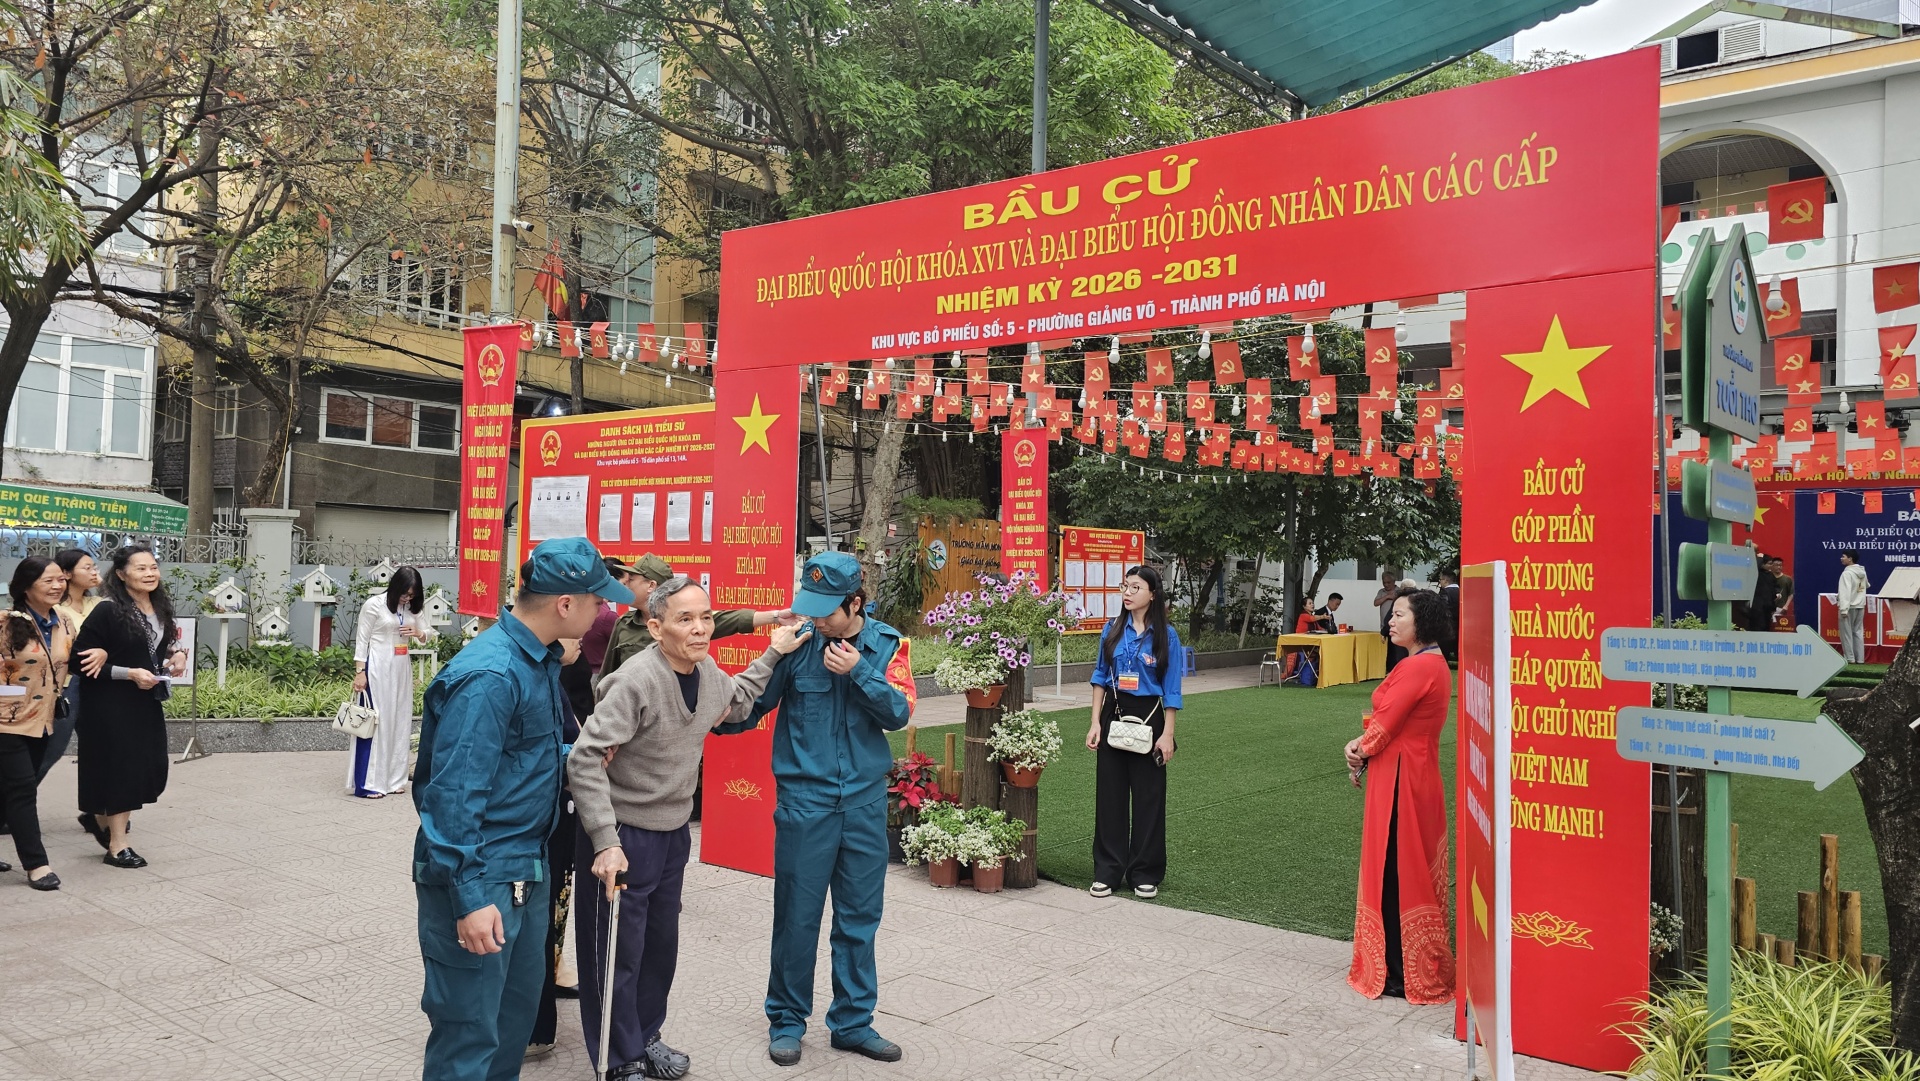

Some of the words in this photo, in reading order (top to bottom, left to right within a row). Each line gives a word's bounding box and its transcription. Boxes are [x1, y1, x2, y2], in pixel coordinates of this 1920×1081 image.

[963, 183, 1080, 231] BẦU
[1102, 154, 1199, 204] CỬ
[757, 274, 784, 308] ĐẠI
[787, 255, 825, 298] BIỂU
[829, 251, 876, 299] QUỐC
[880, 248, 913, 293] HỘI
[917, 241, 969, 279] KHÓA
[971, 242, 1005, 274] XVI
[1009, 228, 1036, 269] VÀ
[1041, 229, 1078, 269] ĐẠI
[1083, 204, 1137, 258] BIỂU
[1142, 203, 1186, 254] HỘI
[1190, 188, 1264, 241] ĐỒNG
[1268, 177, 1348, 229] NHÂN
[1352, 165, 1415, 215] DÂN
[1422, 152, 1484, 203] CÁC
[1492, 132, 1559, 190] CẤP
[936, 286, 1019, 314] NHIỆM
[1028, 276, 1063, 304] KỲ
[1071, 268, 1142, 299] 2026
[871, 334, 895, 350] KHU
[897, 331, 921, 349] VỰC
[923, 326, 940, 345] BỎ
[942, 320, 979, 343] PHIẾU
[982, 318, 1004, 339] SỐ:
[1006, 321, 1015, 336] 5
[1027, 312, 1084, 334] PHƯỜNG
[1087, 304, 1132, 327] GIẢNG
[1136, 300, 1156, 320] VÕ
[1170, 293, 1223, 316] THÀNH
[1227, 284, 1263, 306] PHỐ
[1266, 281, 1291, 304] HÀ
[1294, 278, 1326, 301] NỘI
[600, 427, 620, 437] DANH
[622, 424, 642, 436] SÁCH
[643, 422, 654, 434] VÀ
[655, 419, 672, 432] TIỂU
[674, 419, 686, 431] SỬ
[1523, 457, 1558, 496] BẦU
[1560, 458, 1586, 496] CỬ
[0, 490, 19, 501] EM
[24, 493, 50, 505] QUE
[54, 496, 96, 511] TRÀNG
[100, 500, 127, 514] TIỀN
[0, 506, 18, 517] EM
[22, 504, 38, 519] ỐC
[42, 508, 68, 522] QUẾ
[742, 489, 754, 514] BẦU
[756, 490, 766, 514] CỬ
[723, 526, 734, 548] ĐẠI
[735, 517, 750, 544] BIỂU
[752, 519, 770, 548] QUỐC
[770, 522, 782, 548] HỘI
[1512, 508, 1546, 543] GÓP
[1548, 504, 1595, 542] PHẦN
[1856, 528, 1874, 538] ĐẠI
[1878, 524, 1904, 536] BIỂU
[1822, 539, 1836, 550] VÀ
[1860, 538, 1885, 550] BIỂU
[1888, 540, 1908, 552] HỘI
[1884, 554, 1916, 563] NHIỆM
[736, 552, 754, 575] KHÓA
[755, 557, 766, 574] XVI
[1510, 556, 1543, 590] XÂY
[1545, 559, 1594, 598] DỰNG
[716, 582, 724, 604] VÀ
[725, 587, 736, 608] ĐẠI
[737, 578, 752, 605] BIỂU
[754, 583, 766, 608] HỘI
[766, 581, 784, 606] ĐỒNG
[1510, 603, 1544, 638] NHÀ
[1547, 603, 1594, 640] NƯỚC
[717, 643, 738, 668] NHIỆM
[1607, 636, 1620, 649] Tầng
[1628, 638, 1638, 650] Lớp
[1700, 640, 1713, 653] Hiệu
[1746, 641, 1758, 654] phó
[1792, 643, 1802, 656] lớp
[1805, 644, 1812, 656] D1
[1510, 650, 1542, 686] HÁP
[1544, 648, 1602, 692] QUYỀN
[1625, 659, 1638, 672] Tầng
[1639, 661, 1645, 672] 2:
[1647, 661, 1664, 673] Phòng
[1736, 666, 1746, 678] lớp
[1511, 697, 1528, 738] ỘI
[1532, 698, 1568, 736] CHỦ
[1572, 706, 1617, 740] NGHĨ
[1642, 716, 1655, 729] Tầng
[1657, 718, 1663, 729] 3:
[1665, 719, 1684, 732] Phòng
[1686, 720, 1696, 733] thể
[1698, 722, 1712, 734] chất
[1720, 725, 1740, 738] phòng
[1742, 725, 1753, 738] thể
[1754, 727, 1769, 740] chất
[1770, 729, 1775, 741] 2
[1511, 746, 1548, 788] VIỆT
[1550, 756, 1588, 788] NAM
[1630, 738, 1643, 752] Tầng
[1665, 743, 1676, 755] phó
[1714, 749, 1733, 762] phòng
[1736, 751, 1752, 764] Nhân
[1772, 754, 1785, 768] Nhà
[1787, 755, 1800, 770] Bếp
[1511, 794, 1540, 832] ỮNG
[1544, 804, 1595, 840] MẠNH
[1598, 810, 1604, 839] !
